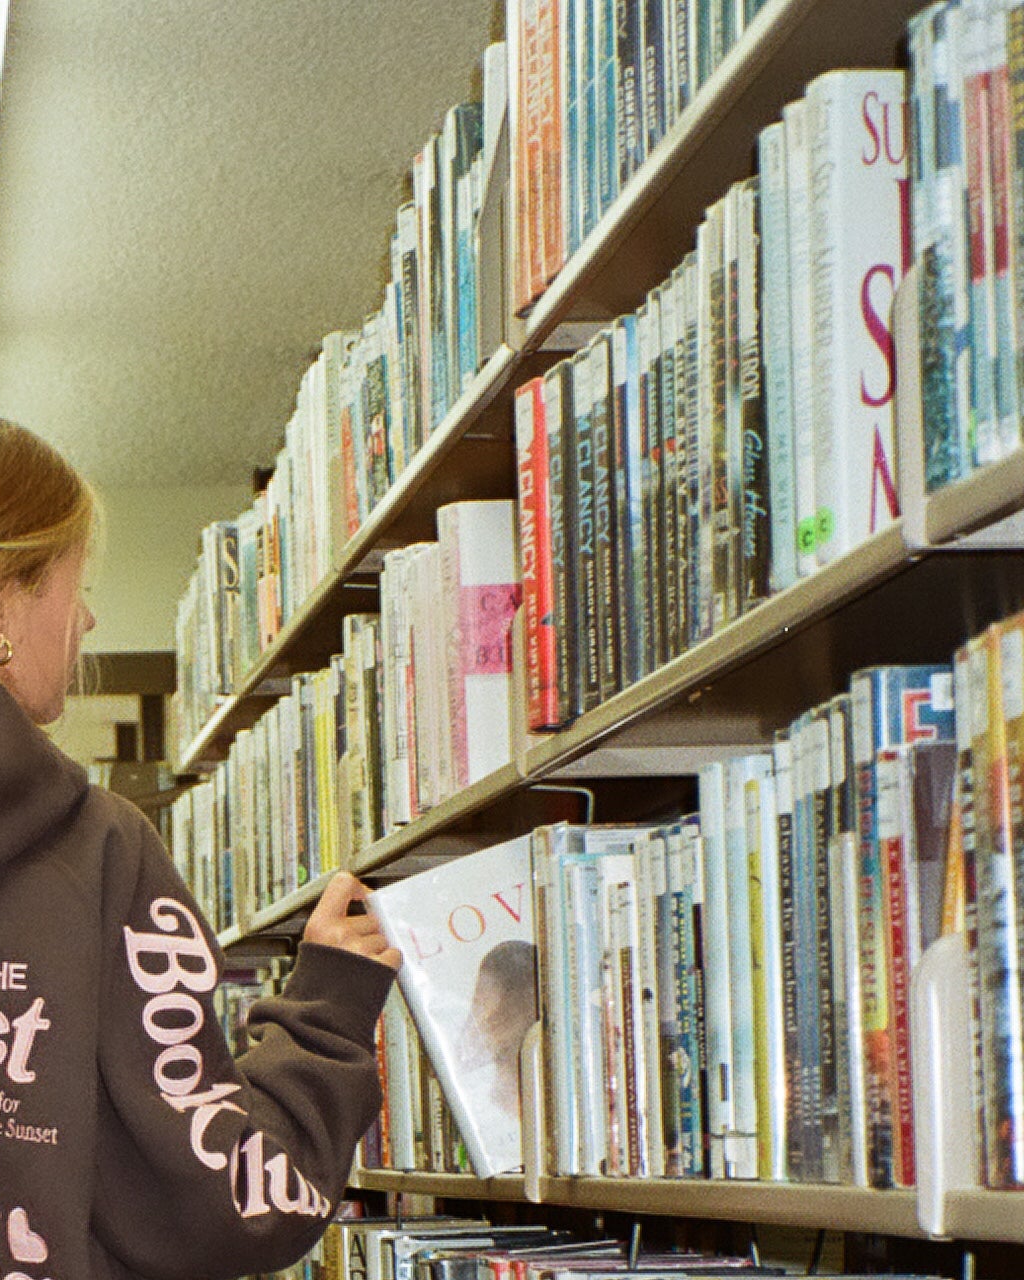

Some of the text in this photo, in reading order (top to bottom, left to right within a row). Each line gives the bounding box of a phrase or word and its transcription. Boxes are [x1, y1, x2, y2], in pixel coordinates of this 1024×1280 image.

[645, 44, 657, 132] COMMAND
[520, 470, 537, 581] CLANCY
[549, 454, 566, 569] CLANCY
[576, 440, 594, 555] CLANCY
[594, 425, 611, 544] CLANCY
[779, 815, 798, 1033] always the husband
[818, 940, 830, 980] THE
[122, 897, 242, 1113] Book
[819, 987, 833, 1065] BEACH
[6, 1118, 58, 1144] Sunset
